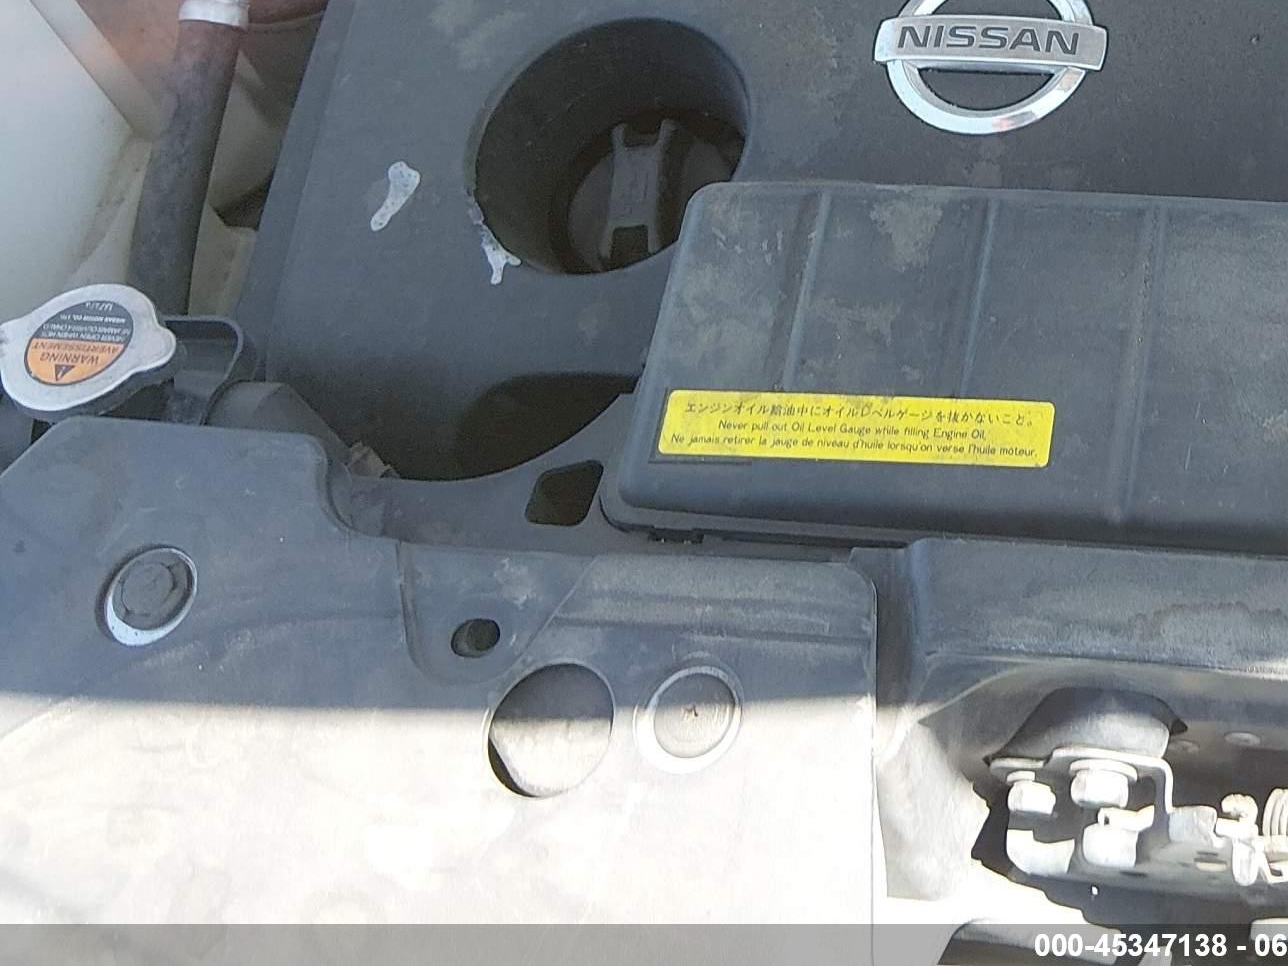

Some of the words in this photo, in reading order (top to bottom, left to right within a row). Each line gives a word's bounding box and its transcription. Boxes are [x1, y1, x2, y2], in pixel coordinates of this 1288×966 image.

[898, 24, 1080, 66] NISSAN
[32, 341, 120, 354] AVERTISSEMENT
[39, 352, 99, 365] WARNING
[718, 419, 748, 432] Never
[751, 420, 769, 434] pull
[771, 421, 787, 432] out
[791, 420, 805, 433] Oil
[808, 421, 837, 434] Level
[840, 422, 871, 436] Gauge
[875, 423, 900, 436] while
[904, 424, 930, 439] filling
[933, 426, 968, 441] Engine
[671, 433, 685, 444] Ne
[689, 434, 720, 447] jamais
[723, 434, 755, 445] retirer
[759, 434, 767, 446] la
[771, 436, 798, 449] jauge
[802, 436, 813, 447] de
[817, 437, 849, 449] niveau
[852, 439, 884, 450] d'huile
[887, 440, 933, 455] lorsqu'on
[936, 444, 965, 453] verse
[968, 443, 996, 455] l'huile
